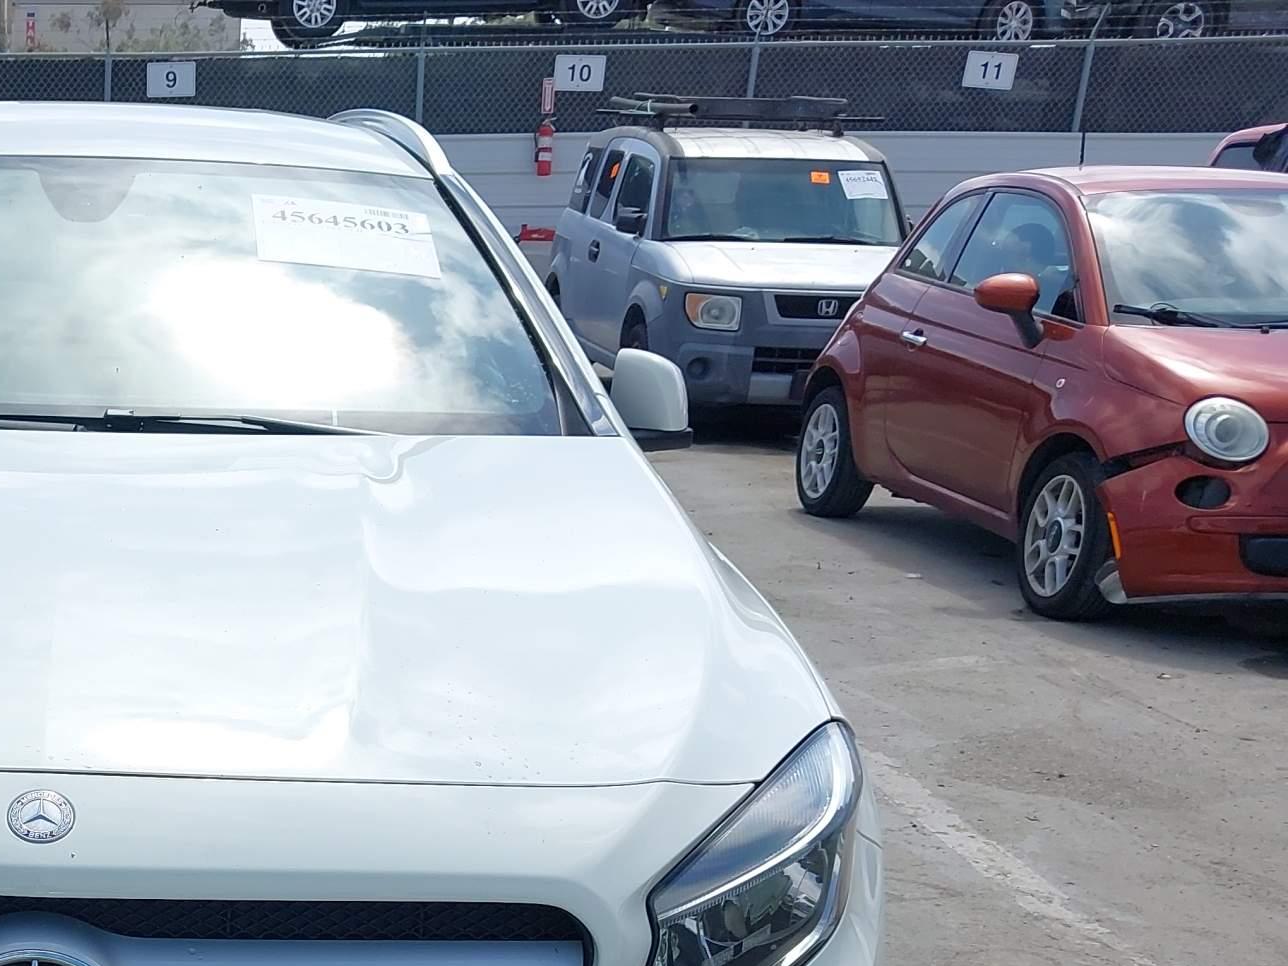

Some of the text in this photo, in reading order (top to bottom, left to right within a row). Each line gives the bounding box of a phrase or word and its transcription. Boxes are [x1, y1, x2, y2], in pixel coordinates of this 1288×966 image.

[165, 71, 177, 88] 9
[567, 64, 592, 82] 10
[980, 61, 1002, 80] 11
[272, 209, 409, 235] 45645603
